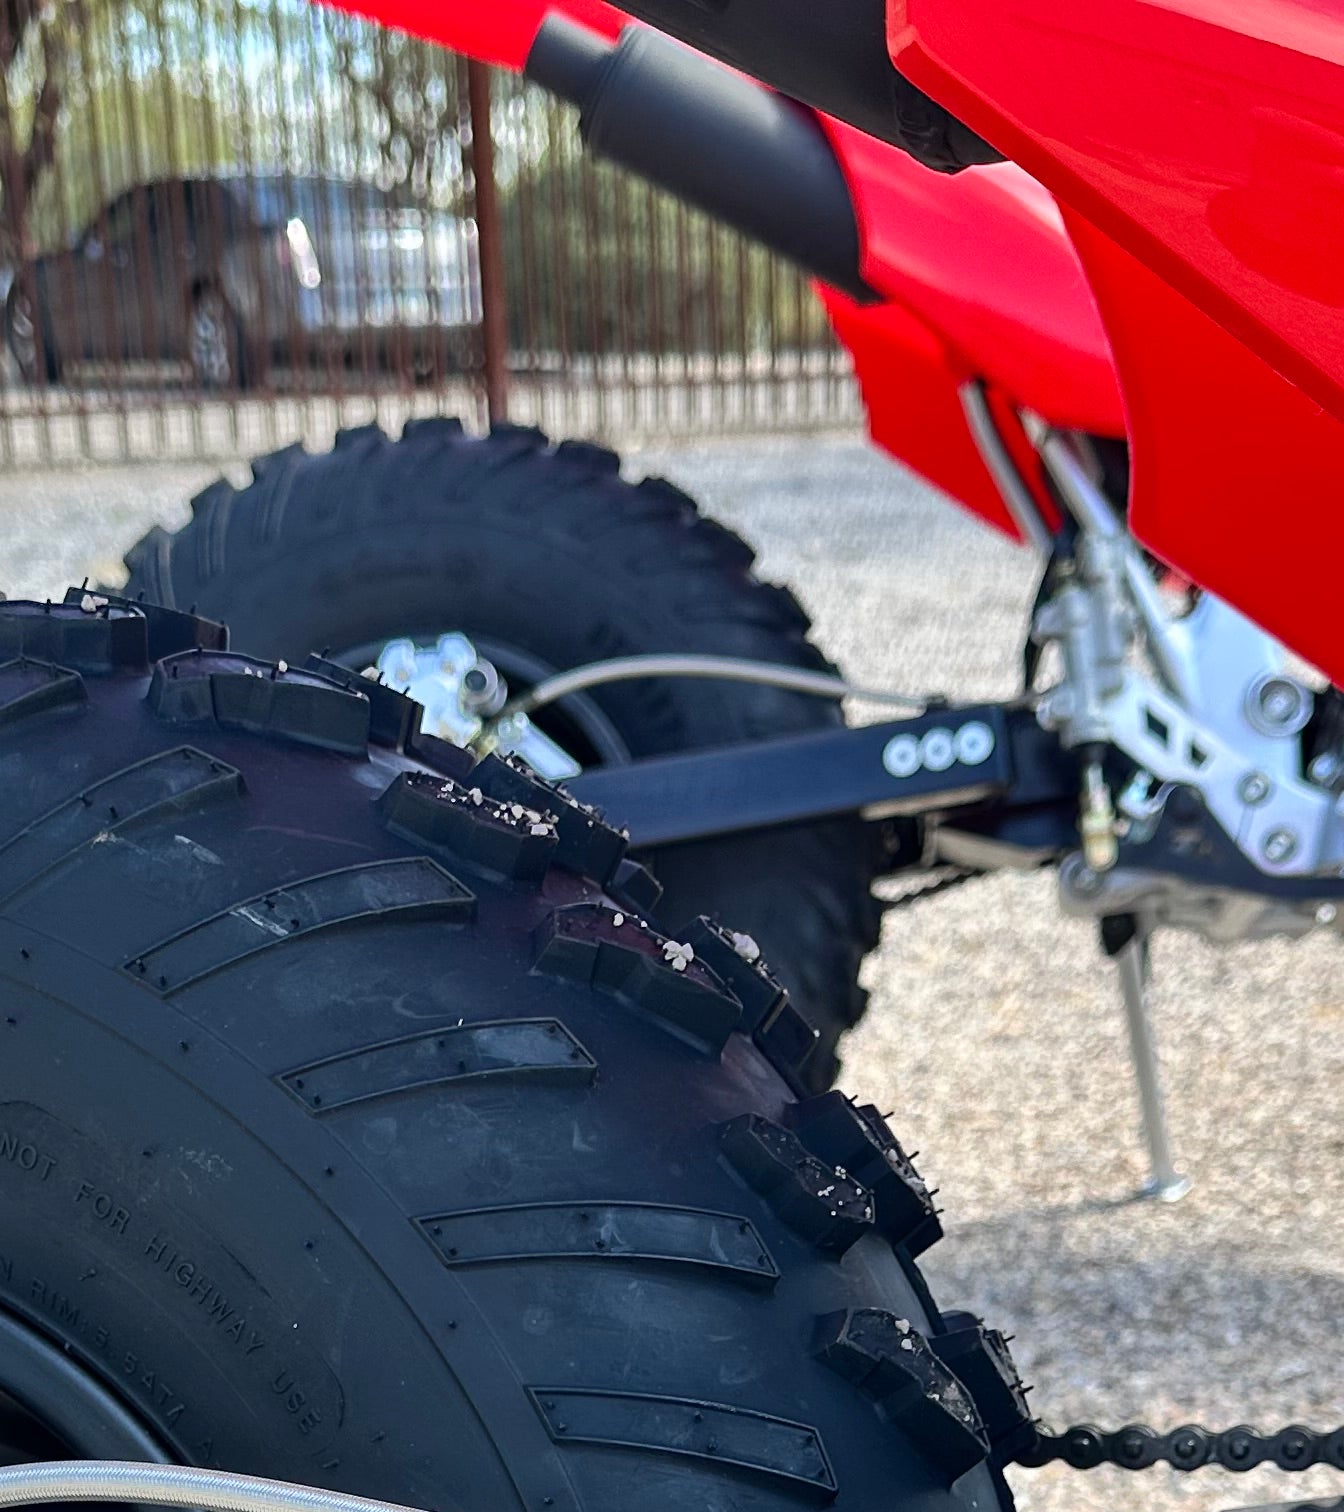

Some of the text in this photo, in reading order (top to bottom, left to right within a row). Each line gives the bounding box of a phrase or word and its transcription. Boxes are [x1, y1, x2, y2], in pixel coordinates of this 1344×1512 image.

[0, 1132, 322, 1434] NOT FOR HIGHWAY USE
